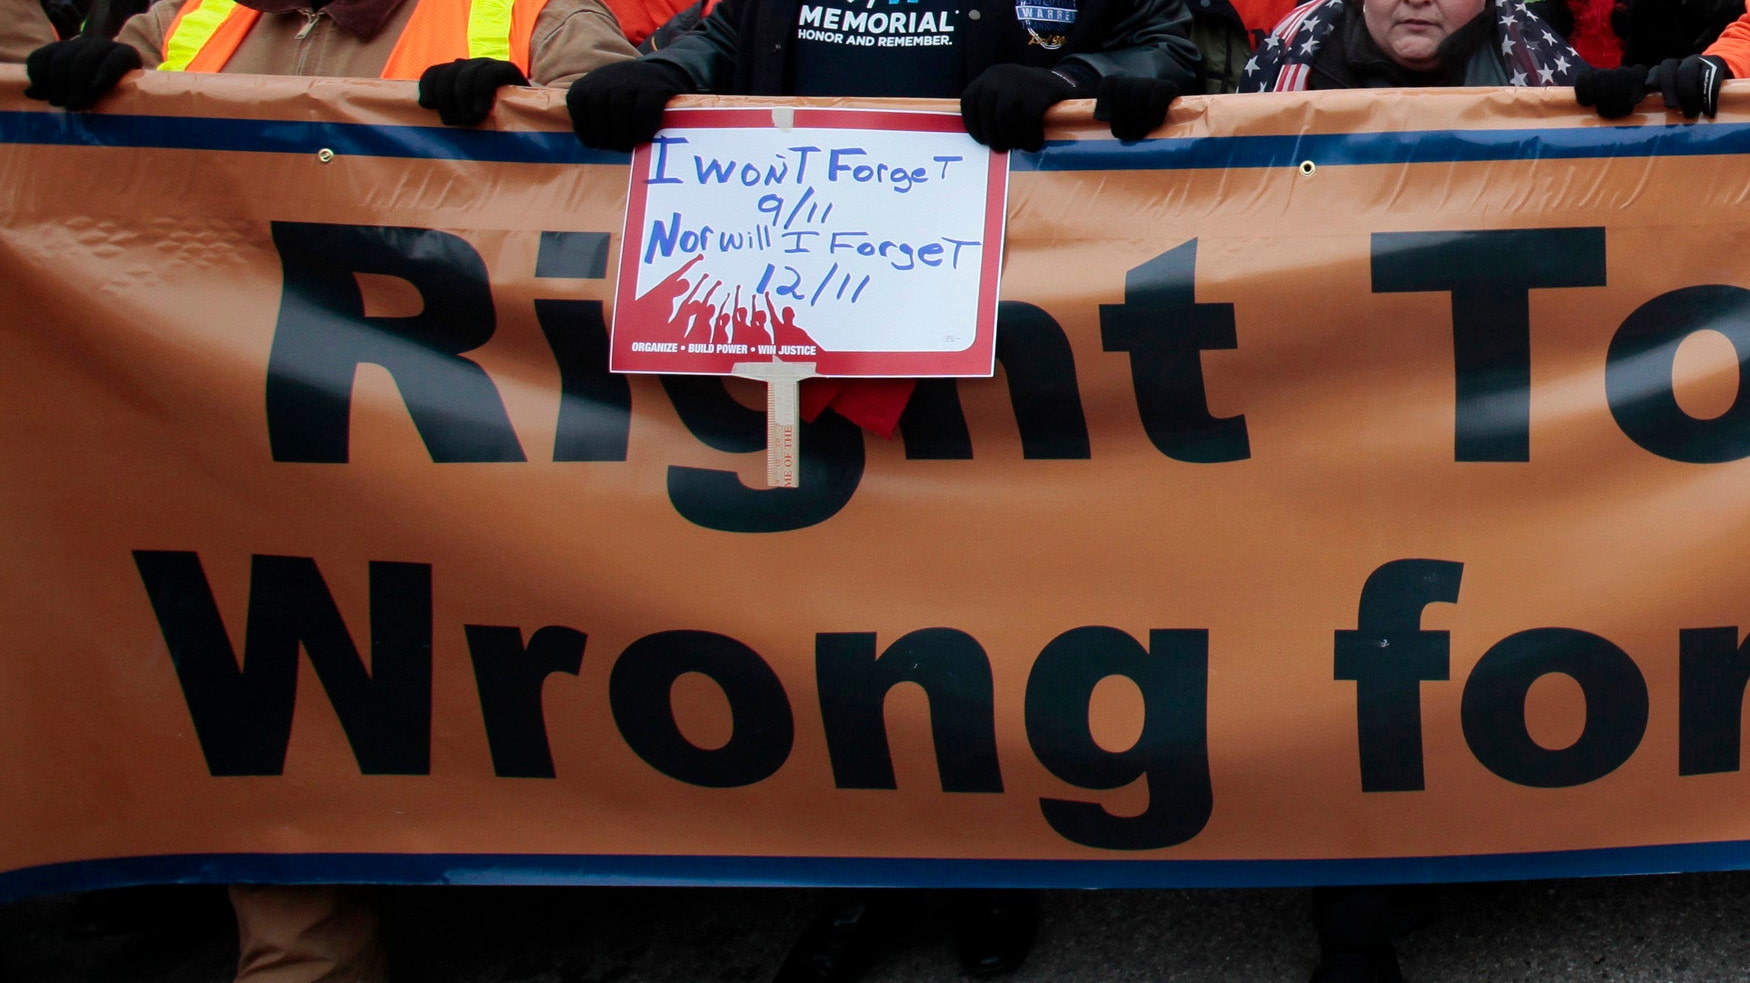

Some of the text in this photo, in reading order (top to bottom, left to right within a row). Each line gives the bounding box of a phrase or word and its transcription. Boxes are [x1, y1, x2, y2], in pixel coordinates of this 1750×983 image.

[798, 29, 953, 47] HONOR AND REMEMBER.
[799, 4, 954, 34] MEMORIAL
[643, 135, 689, 185] I
[758, 186, 833, 230] 9/11
[645, 212, 714, 264] Nor
[719, 224, 771, 251] will
[781, 231, 820, 253] I
[756, 262, 870, 306] 12/11
[632, 342, 817, 356] ORGANIZE BUILD POWER WIN JUSTICE
[132, 549, 1214, 851] Wrong
